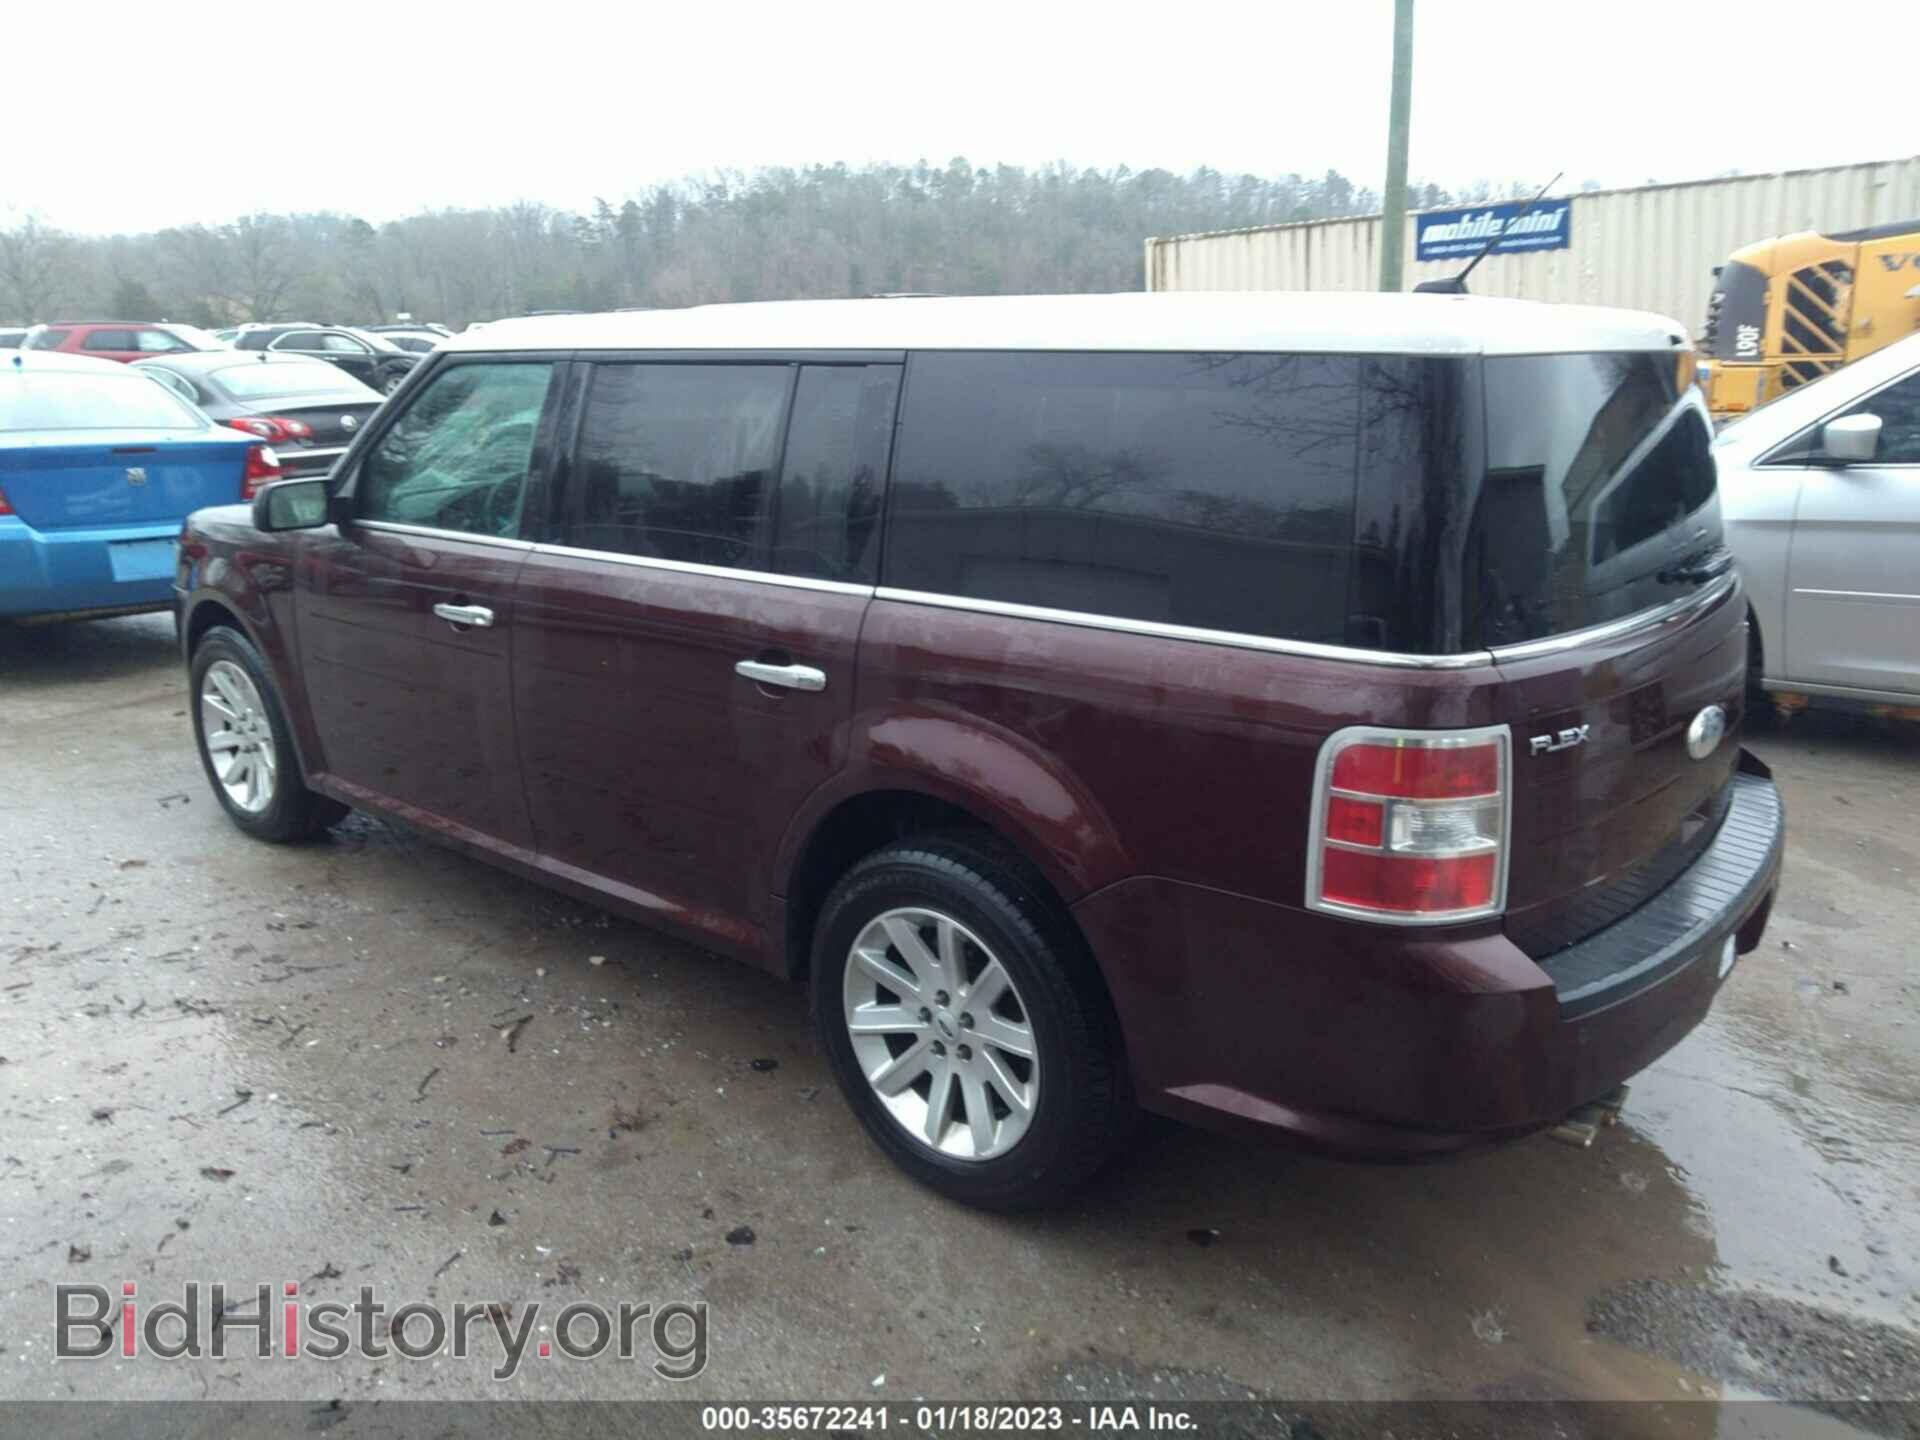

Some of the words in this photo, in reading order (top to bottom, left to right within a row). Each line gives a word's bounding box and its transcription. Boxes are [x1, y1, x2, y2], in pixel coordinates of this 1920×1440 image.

[1420, 211, 1504, 243] mobile
[1736, 324, 1760, 357] L90F
[1529, 724, 1590, 756] FLEX
